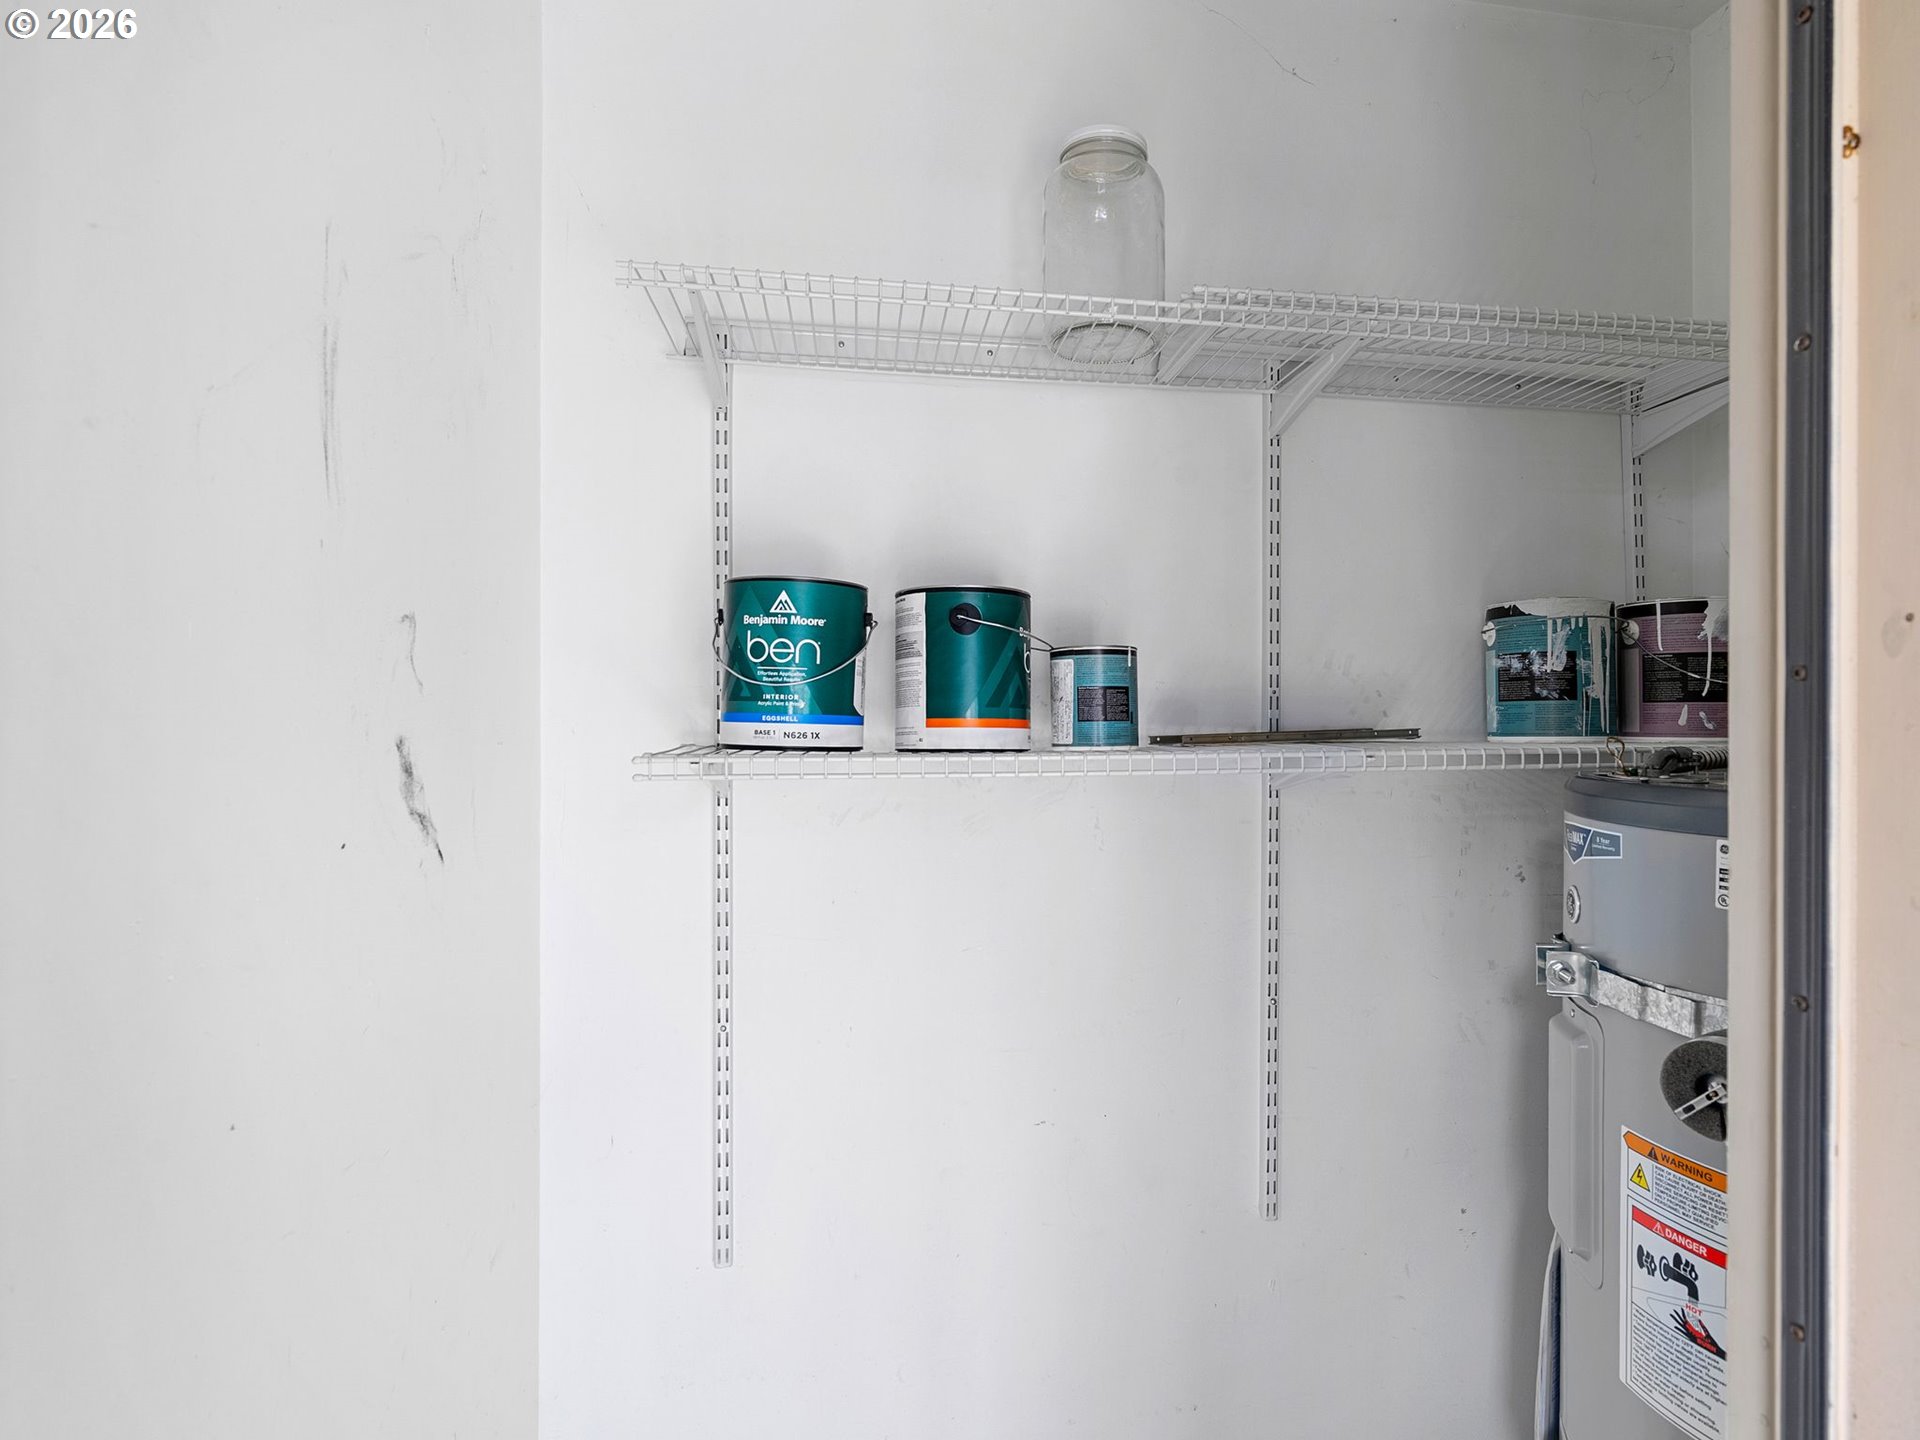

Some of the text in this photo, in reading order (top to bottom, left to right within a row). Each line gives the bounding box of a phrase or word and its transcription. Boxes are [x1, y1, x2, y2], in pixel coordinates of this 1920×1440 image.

[744, 614, 788, 626] Benjamin
[746, 630, 820, 664] ben
[1660, 1152, 1713, 1182] WARNING
[1664, 1175, 1679, 1184] CAUSE
[1680, 1182, 1698, 1193] INJURY
[1672, 1173, 1701, 1189] ELECTRICAL
[1655, 1182, 1671, 1192] BEFORE
[1673, 1190, 1698, 1205] SERVICING
[1655, 1176, 1682, 1192] DISCONNECT
[1694, 1194, 1712, 1206] POWER
[1714, 1203, 1726, 1213] SUPP
[1655, 1197, 1680, 1213] PERSONNEL
[1666, 1197, 1690, 1212] PROPERLY
[1691, 1210, 1719, 1226] QUALIFIED
[1665, 1228, 1708, 1257] DANGER
[1685, 1303, 1703, 1316] HOT
